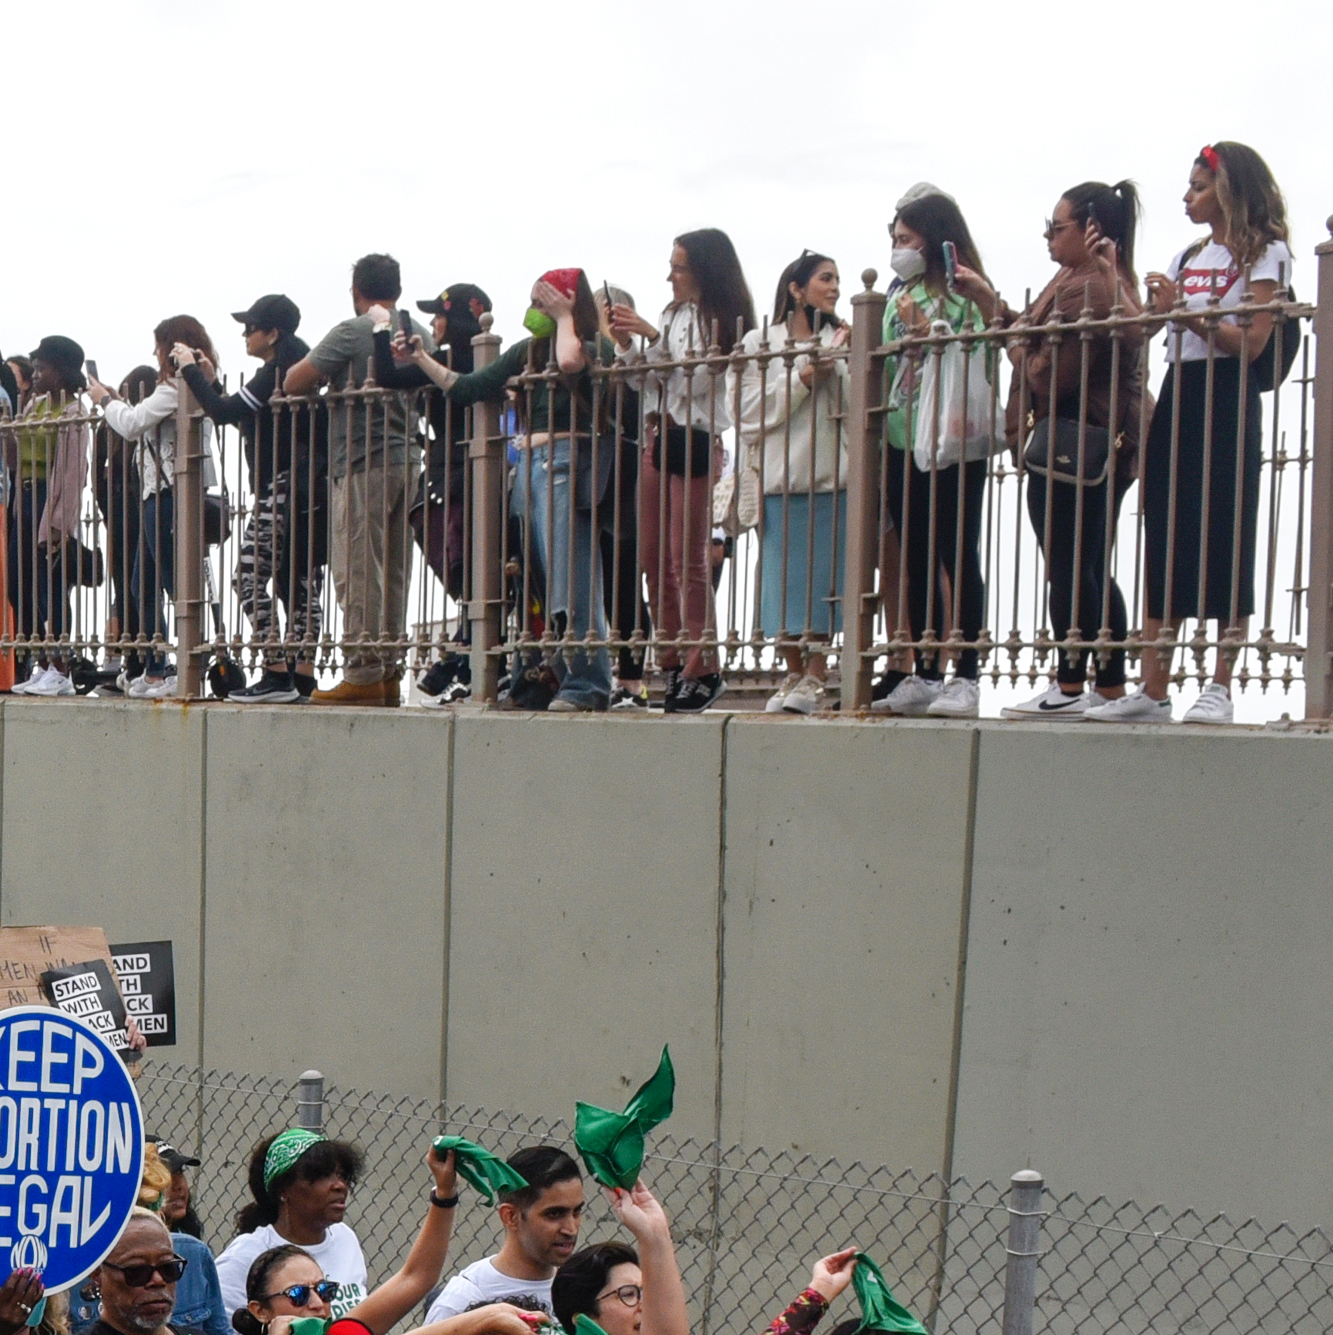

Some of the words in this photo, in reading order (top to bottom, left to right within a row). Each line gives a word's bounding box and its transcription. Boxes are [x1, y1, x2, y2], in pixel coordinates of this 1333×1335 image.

[39, 935, 57, 954] IF
[114, 957, 148, 970] AND
[55, 975, 98, 997] STAND
[120, 979, 137, 991] TH
[8, 989, 28, 1005] AN
[61, 998, 101, 1014] WITH
[88, 1015, 113, 1030] ACK
[137, 1018, 165, 1031] MEN
[104, 1031, 127, 1047] MEN
[336, 1283, 361, 1302] OUR
[332, 1299, 361, 1319] DIES
